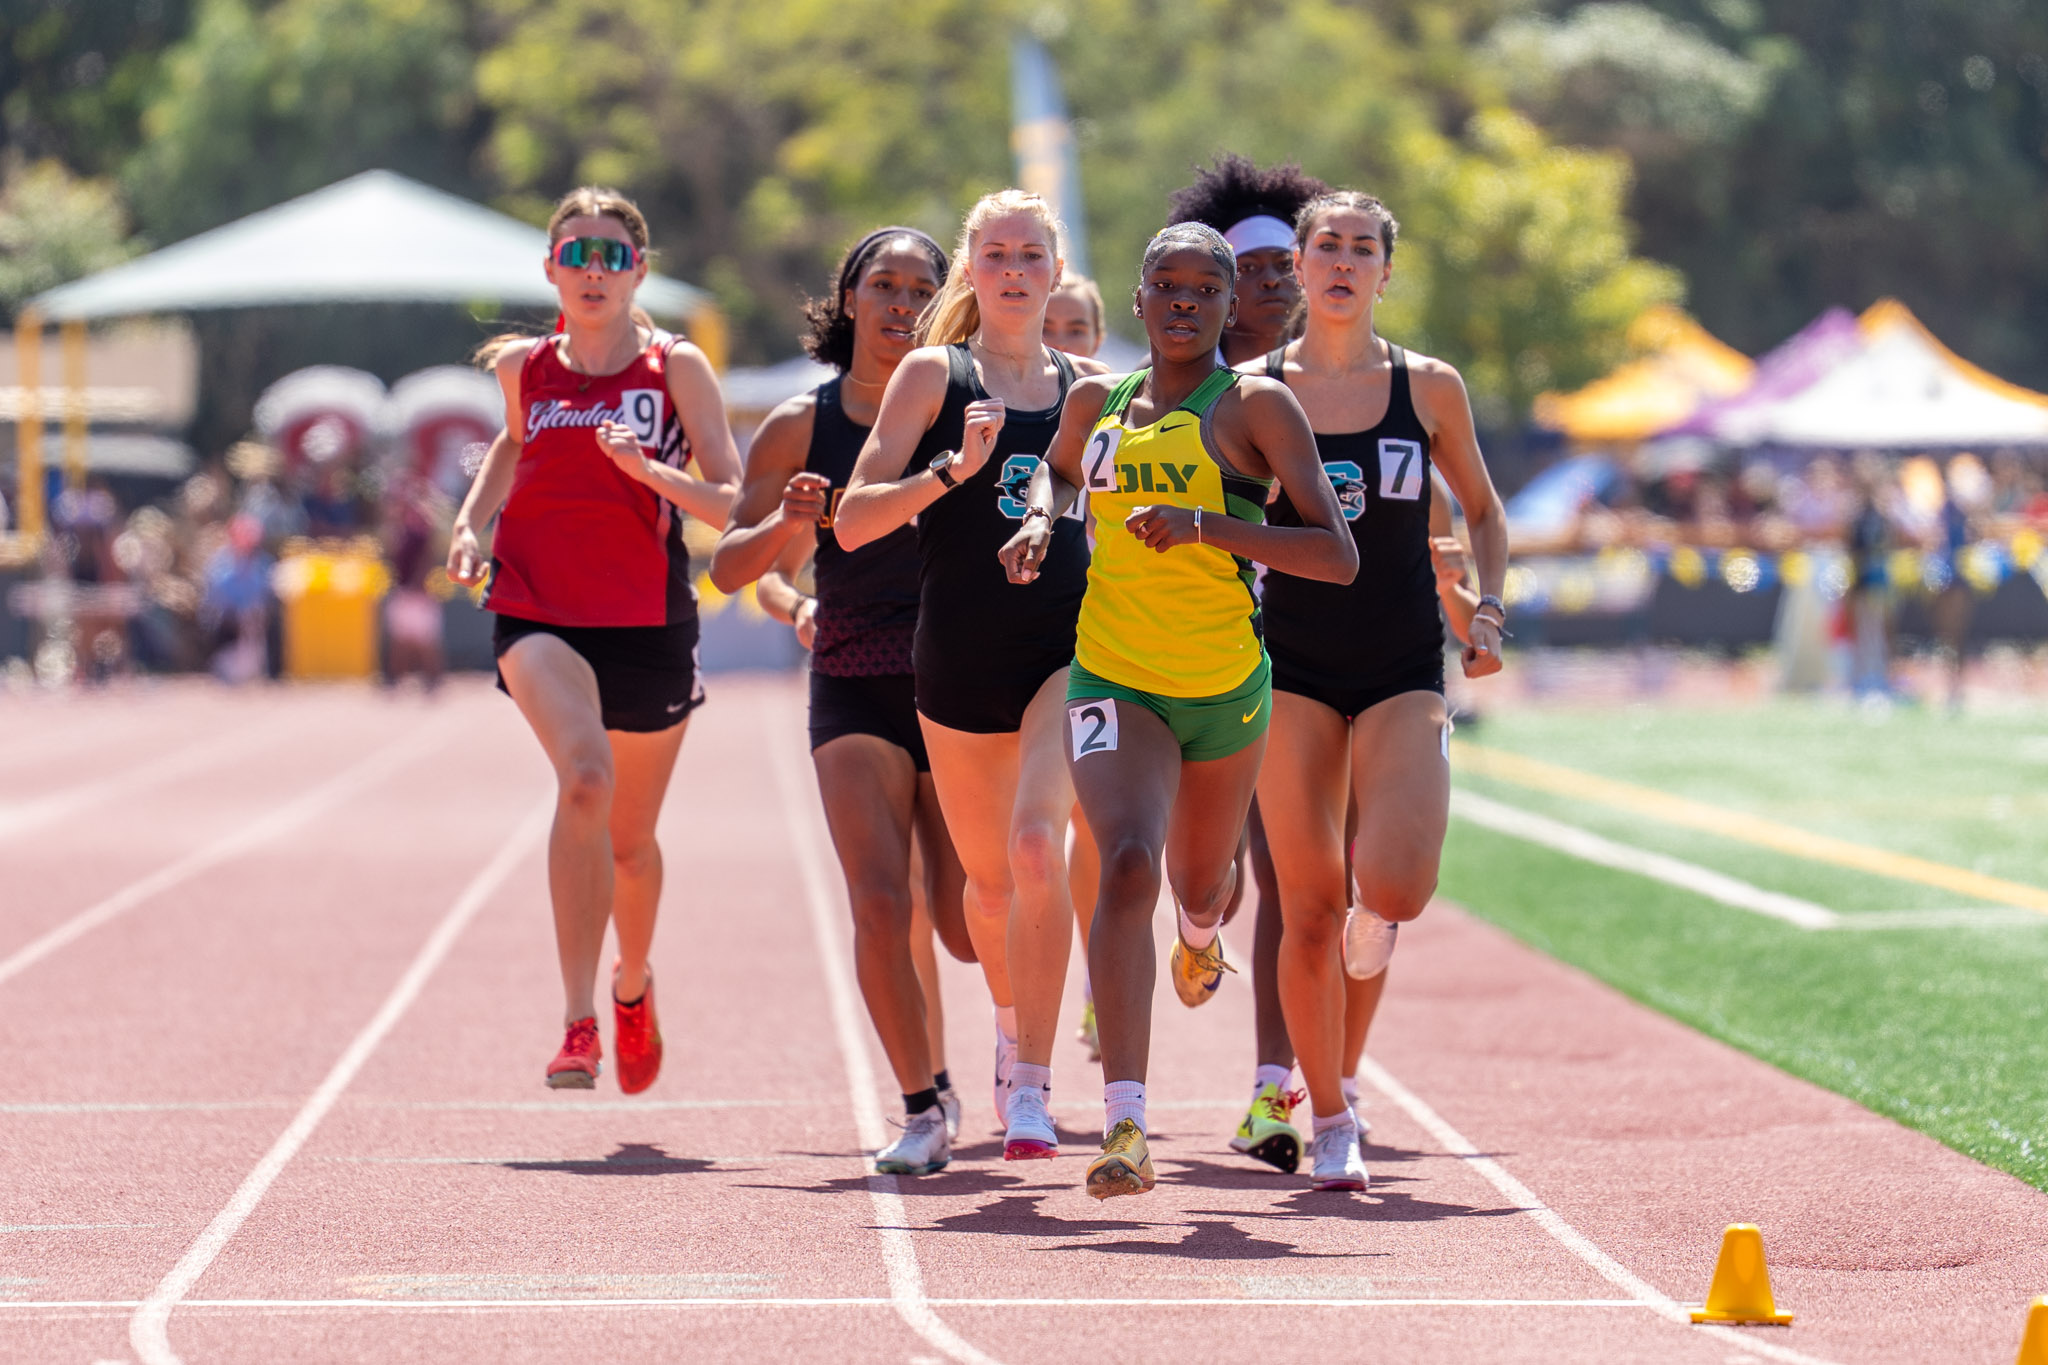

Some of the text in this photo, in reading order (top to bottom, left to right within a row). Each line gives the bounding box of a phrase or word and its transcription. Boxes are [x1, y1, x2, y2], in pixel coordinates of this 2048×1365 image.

[524, 400, 625, 443] Glendal
[633, 393, 656, 442] 9
[1088, 431, 1110, 488] 2
[1109, 462, 1199, 494] OLY
[1384, 444, 1414, 494] 7
[1080, 706, 1107, 755] 2
